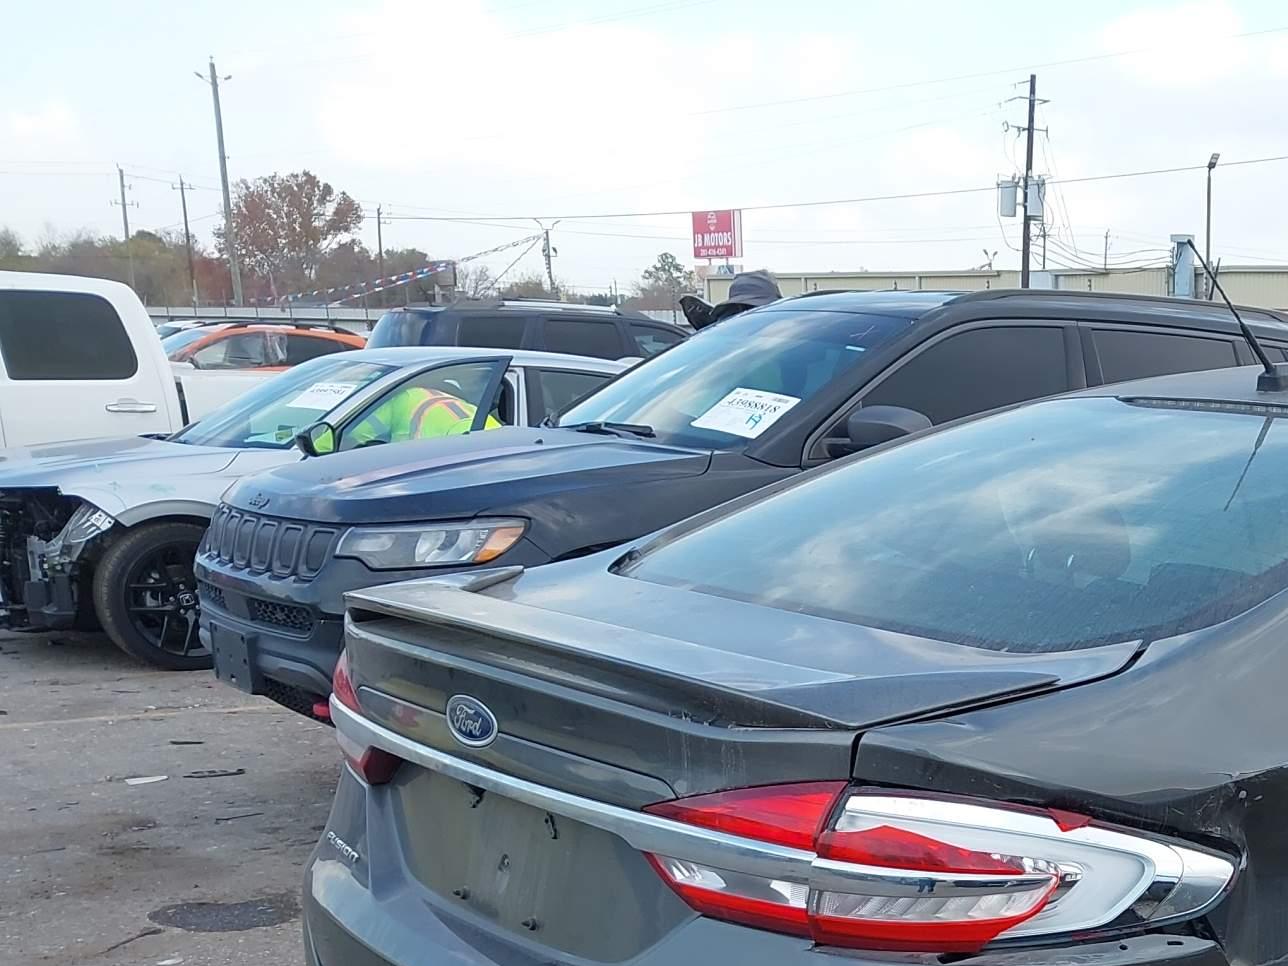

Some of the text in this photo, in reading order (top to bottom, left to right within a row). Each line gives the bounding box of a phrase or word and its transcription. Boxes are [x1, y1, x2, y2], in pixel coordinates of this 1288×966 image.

[694, 231, 732, 248] JB MOTORS
[453, 704, 482, 737] Ford
[326, 831, 360, 863] FUSION
